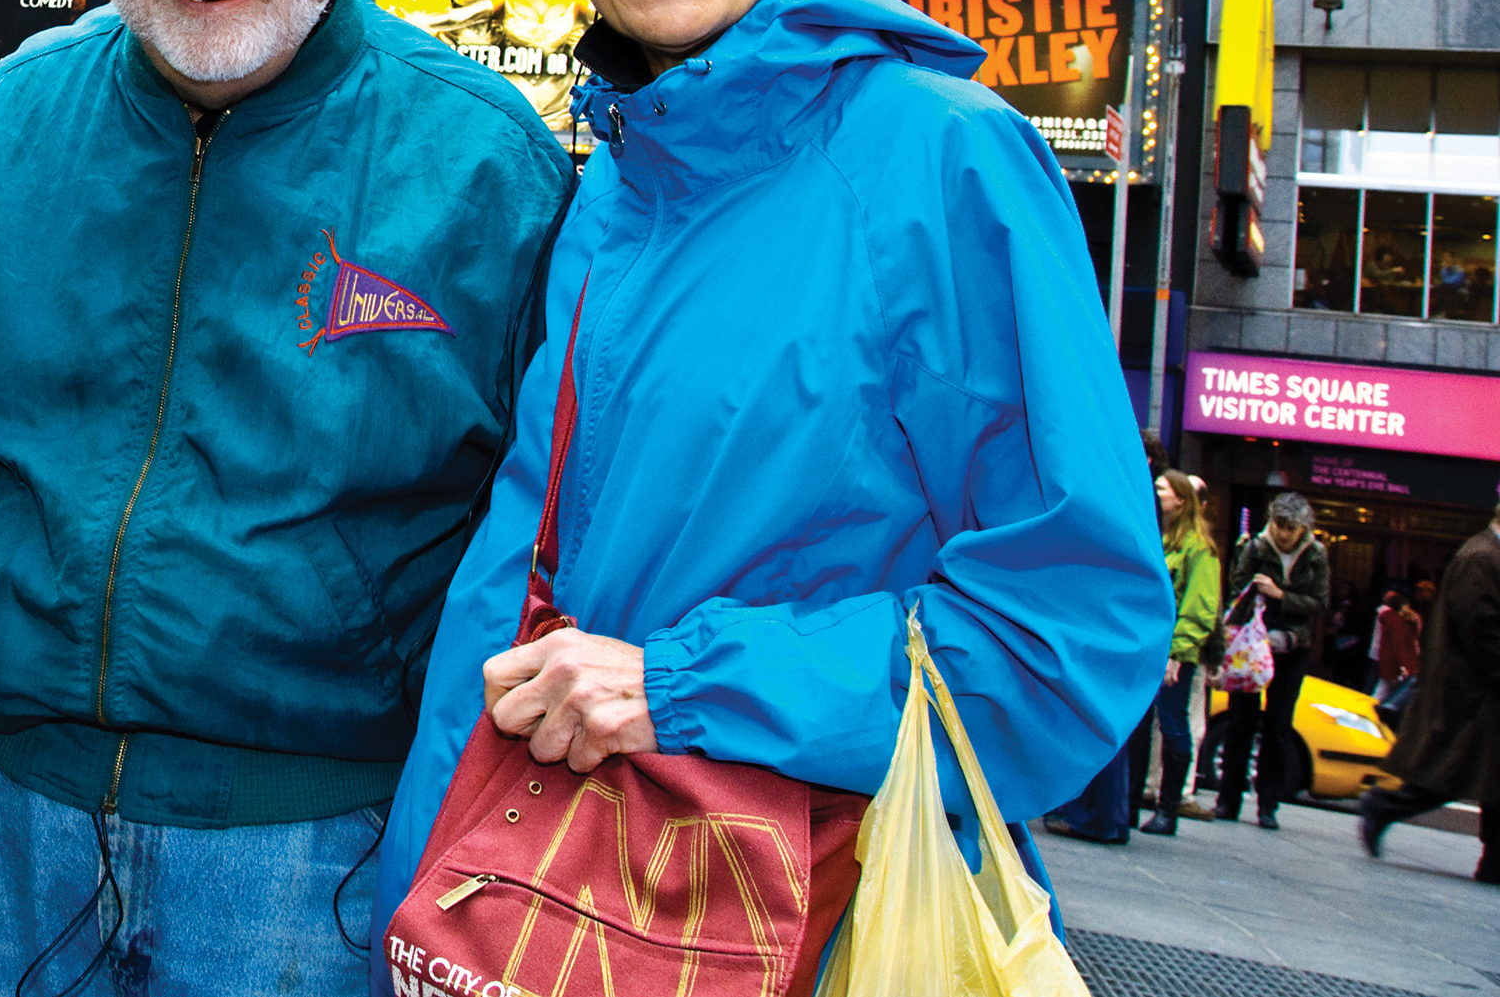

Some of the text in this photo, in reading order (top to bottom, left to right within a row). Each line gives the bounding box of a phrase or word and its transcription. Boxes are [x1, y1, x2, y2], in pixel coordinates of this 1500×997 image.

[547, 54, 567, 75] OR
[972, 28, 1118, 87] KLEY
[295, 252, 326, 330] CLASSIC
[338, 271, 434, 326] UNIVERSAL
[1202, 367, 1390, 407] TIMES SQUARE
[1199, 394, 1405, 437] VISITOR CENTER
[389, 935, 426, 974] THE
[428, 957, 482, 996] CITY
